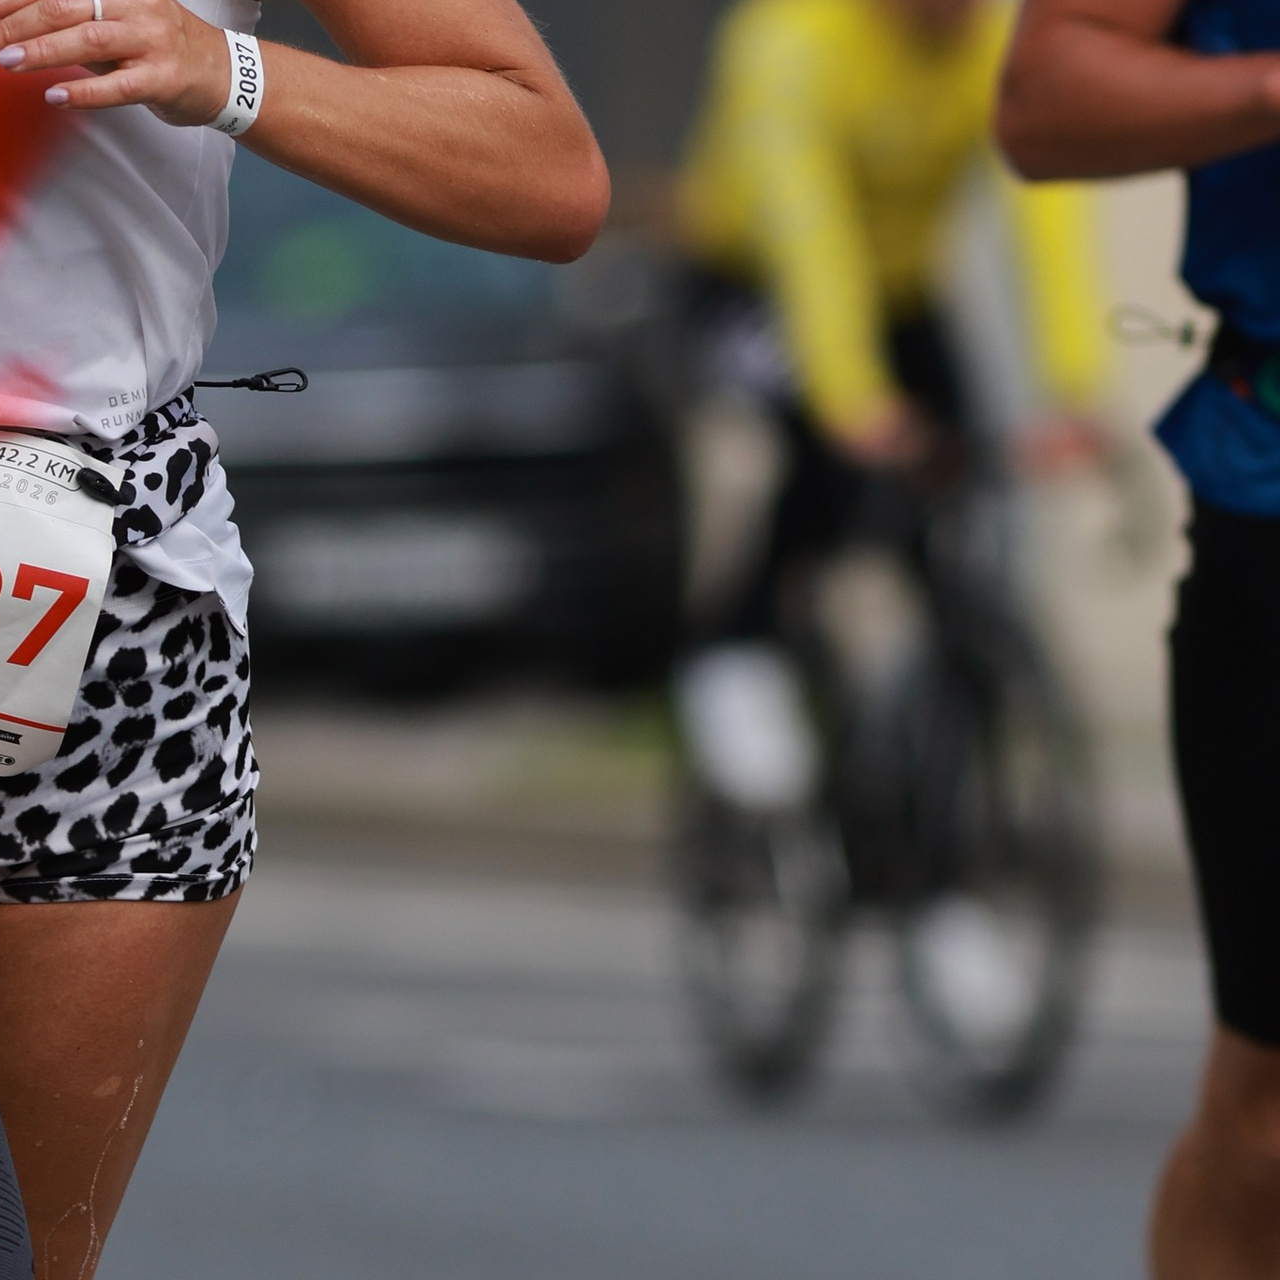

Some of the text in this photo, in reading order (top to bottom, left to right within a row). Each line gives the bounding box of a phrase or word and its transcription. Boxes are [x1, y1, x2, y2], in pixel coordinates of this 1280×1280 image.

[235, 41, 258, 111] 20837
[108, 387, 146, 408] DEMI
[101, 409, 143, 429] RUNN
[0, 473, 59, 505] 2026
